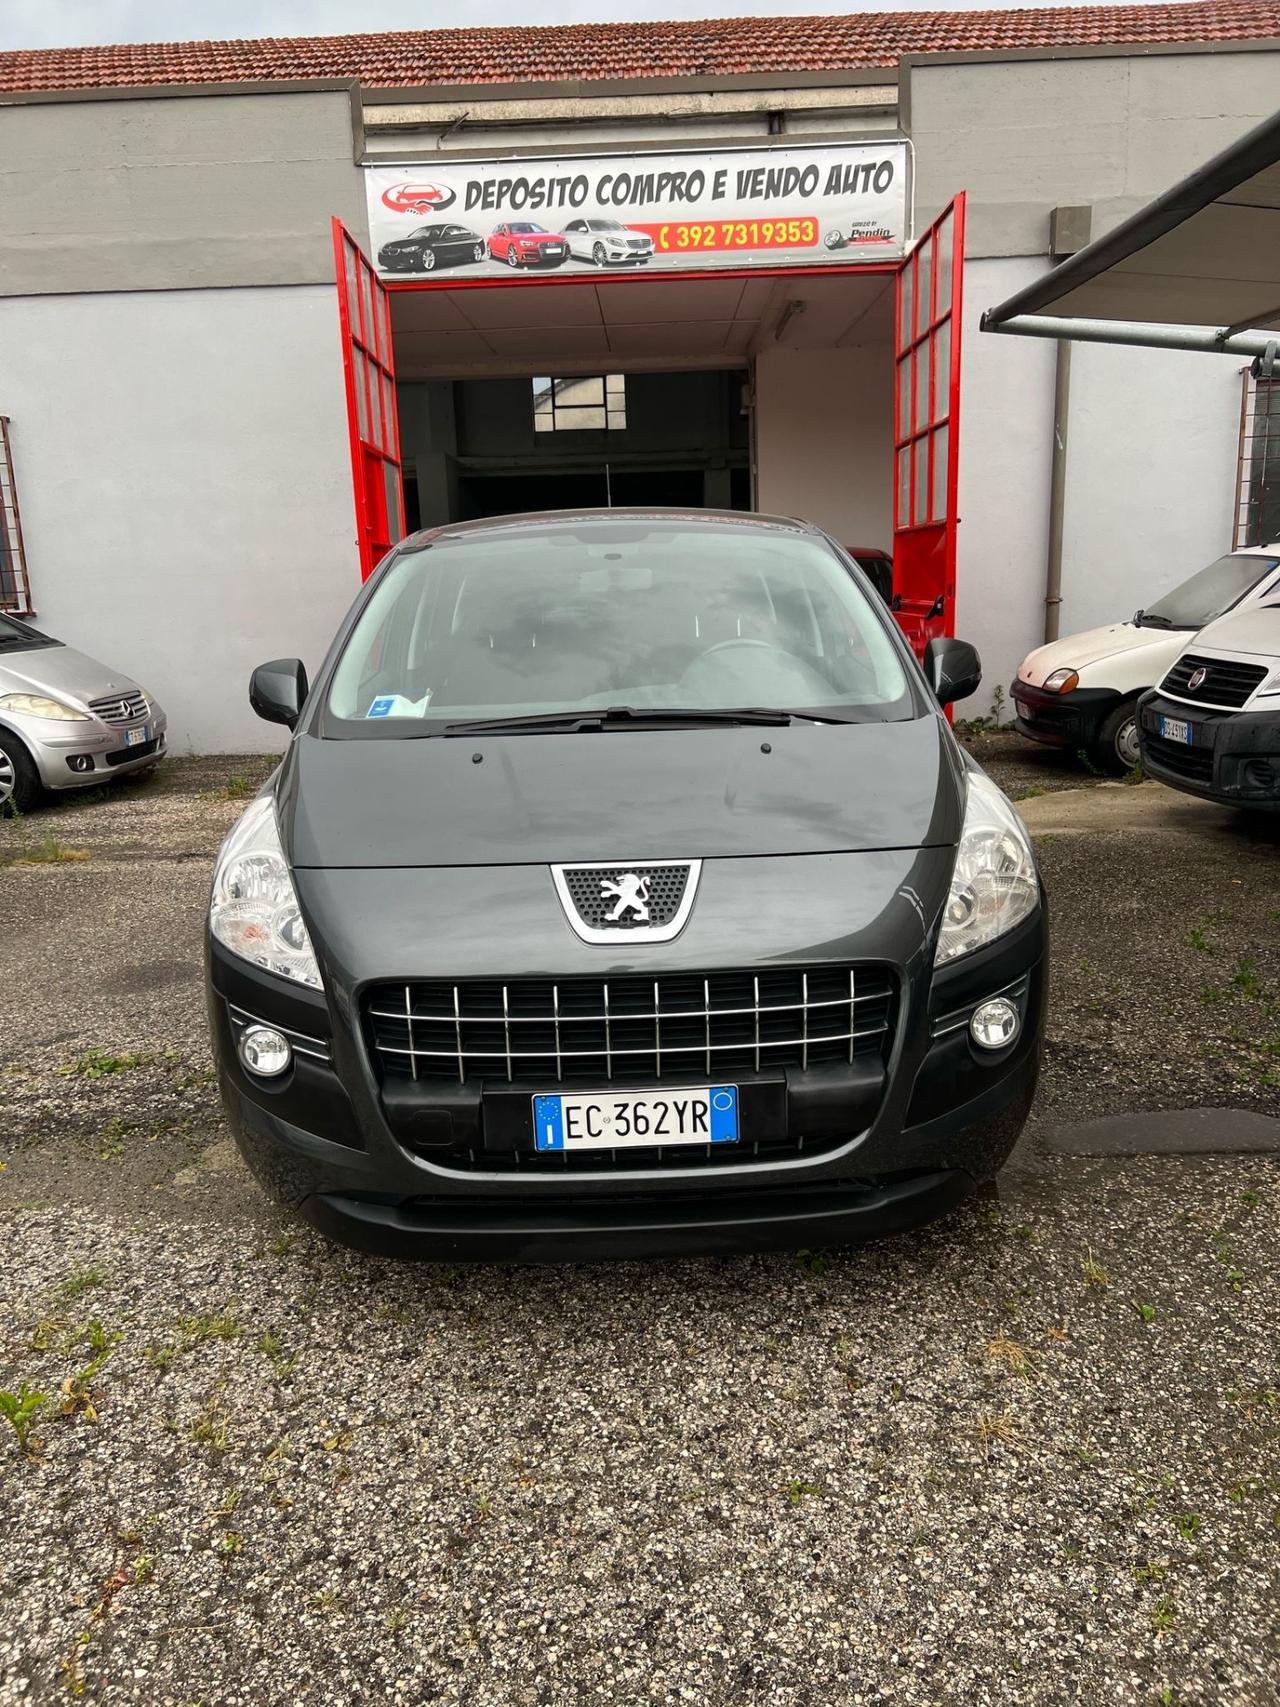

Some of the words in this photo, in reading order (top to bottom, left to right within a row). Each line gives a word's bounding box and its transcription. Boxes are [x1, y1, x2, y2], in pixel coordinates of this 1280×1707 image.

[464, 174, 589, 212] DEPOSITO
[595, 169, 706, 207] COMPRO
[711, 169, 728, 201] E
[736, 164, 820, 201] VENDO
[823, 160, 894, 196] AUTO
[676, 225, 716, 247] 392
[721, 220, 814, 246] 7319353
[565, 1104, 603, 1139] EC
[613, 1099, 709, 1137] 362YR
